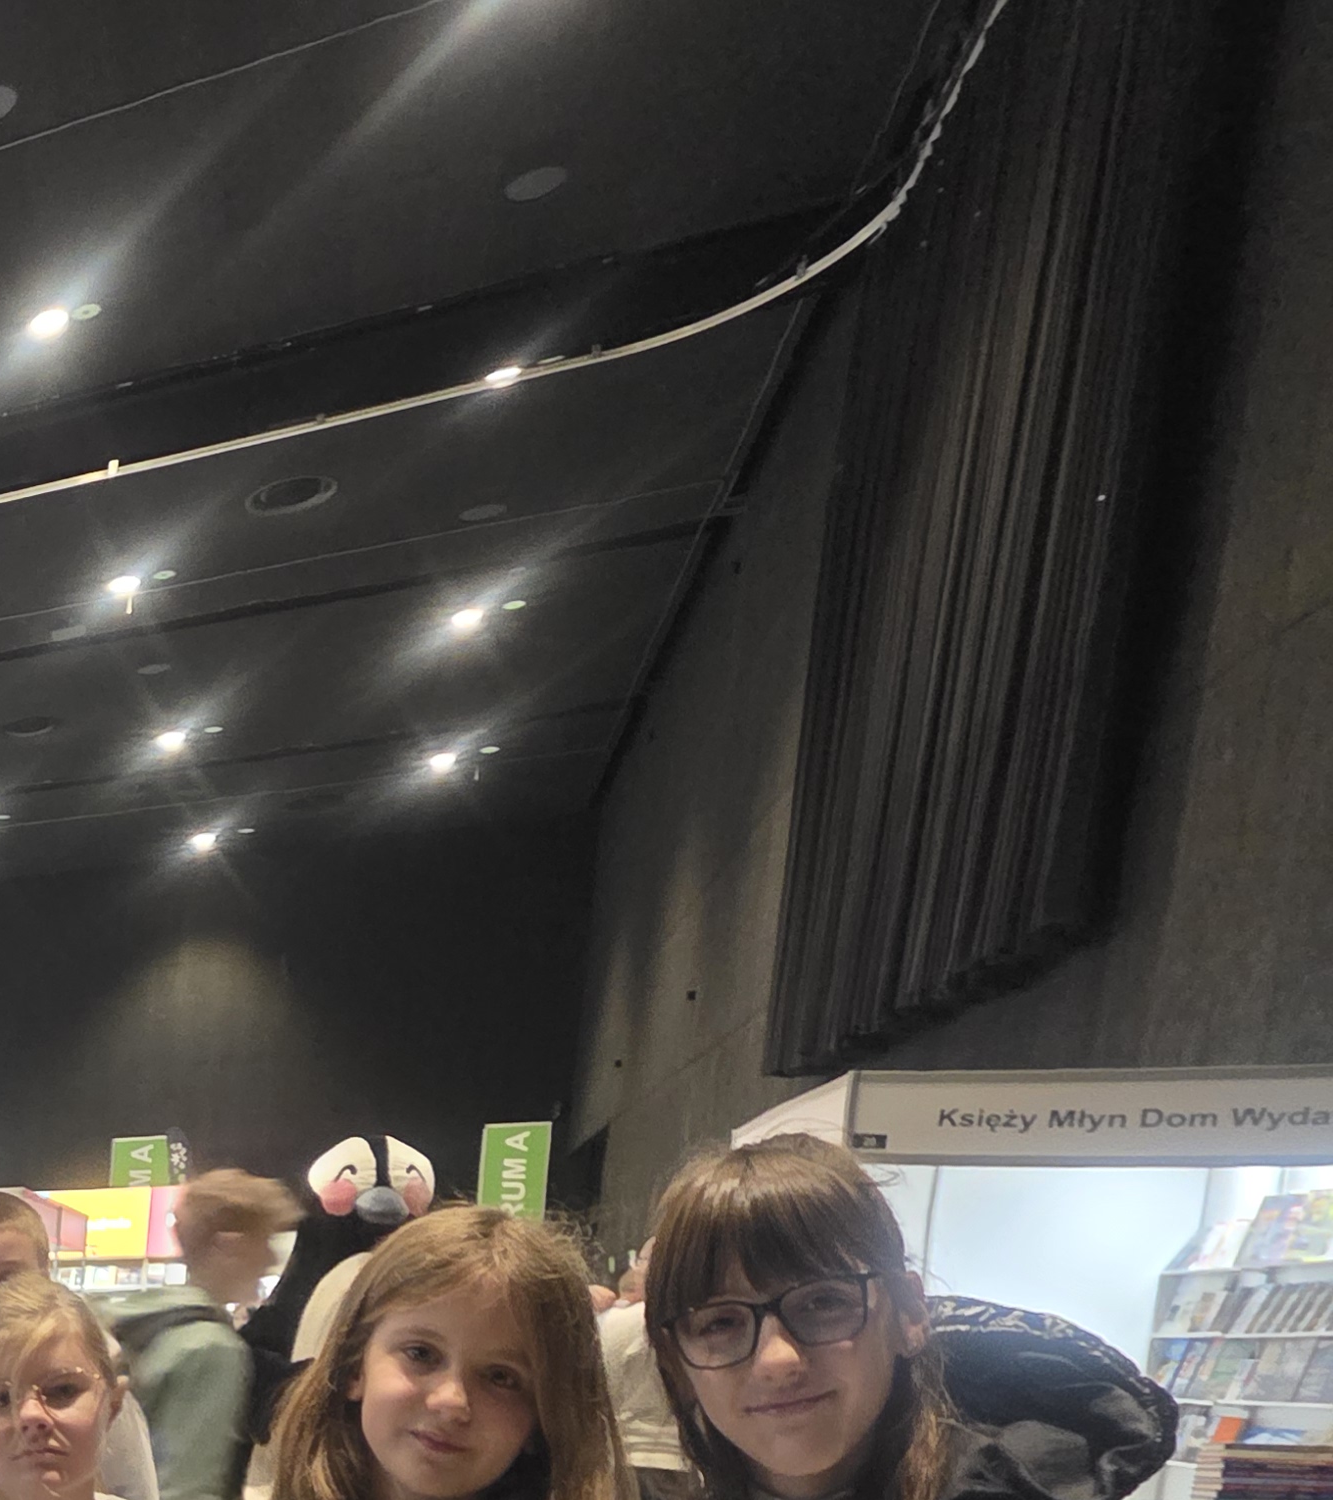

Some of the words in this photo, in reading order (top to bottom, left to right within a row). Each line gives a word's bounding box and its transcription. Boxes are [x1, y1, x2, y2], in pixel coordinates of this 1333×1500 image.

[937, 1107, 1037, 1133] Księży
[1047, 1108, 1128, 1133] Młyn
[1139, 1107, 1219, 1129] Dom
[1231, 1106, 1333, 1131] Wyda
[504, 1130, 532, 1152] A
[130, 1144, 155, 1163] A
